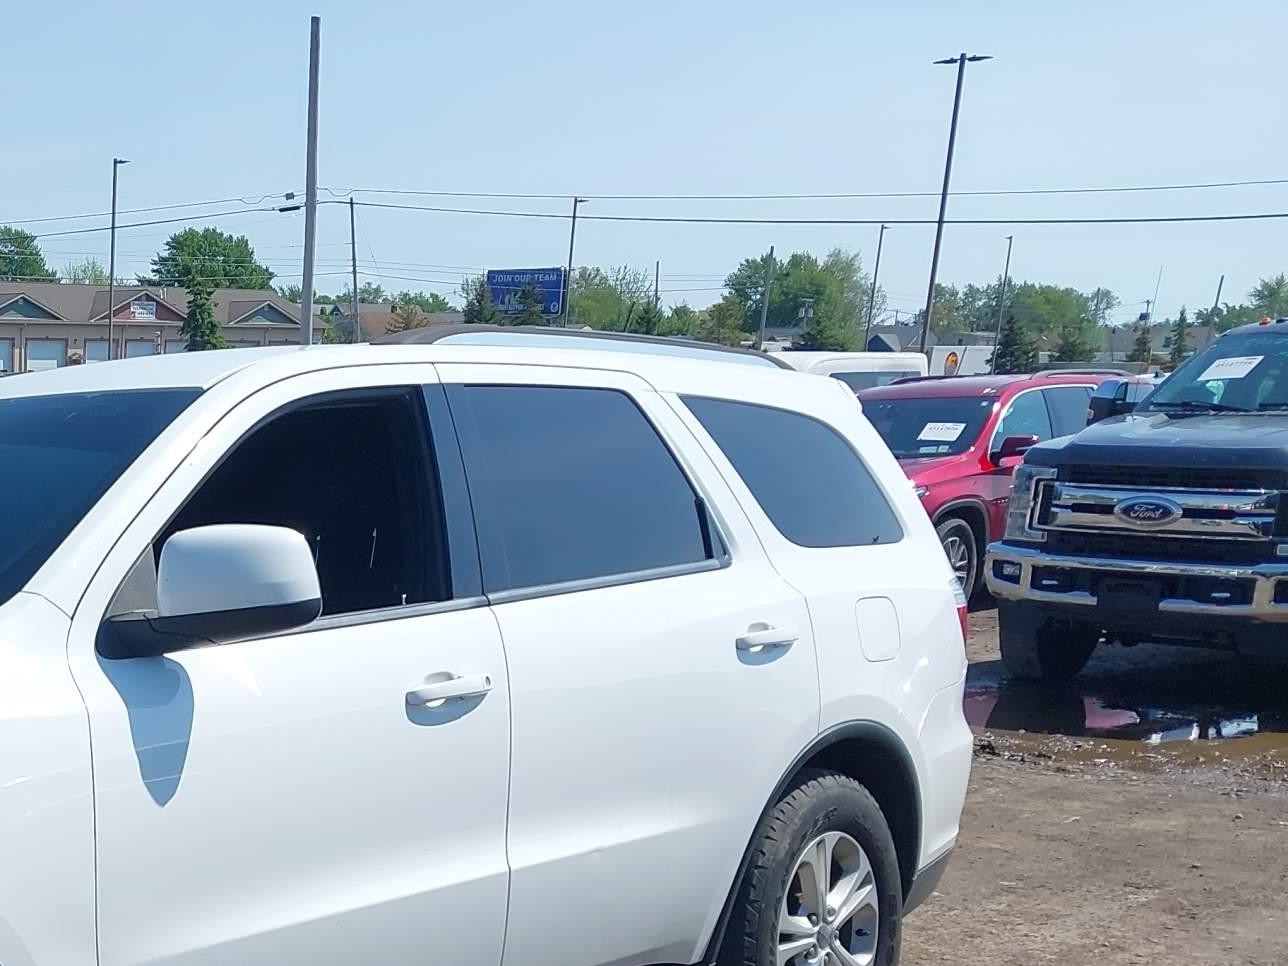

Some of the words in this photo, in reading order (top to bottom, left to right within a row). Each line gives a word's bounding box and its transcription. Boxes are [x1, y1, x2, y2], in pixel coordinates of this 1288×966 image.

[493, 274, 512, 283] JOIN
[535, 272, 557, 281] TEAM
[1129, 504, 1163, 519] Ford
